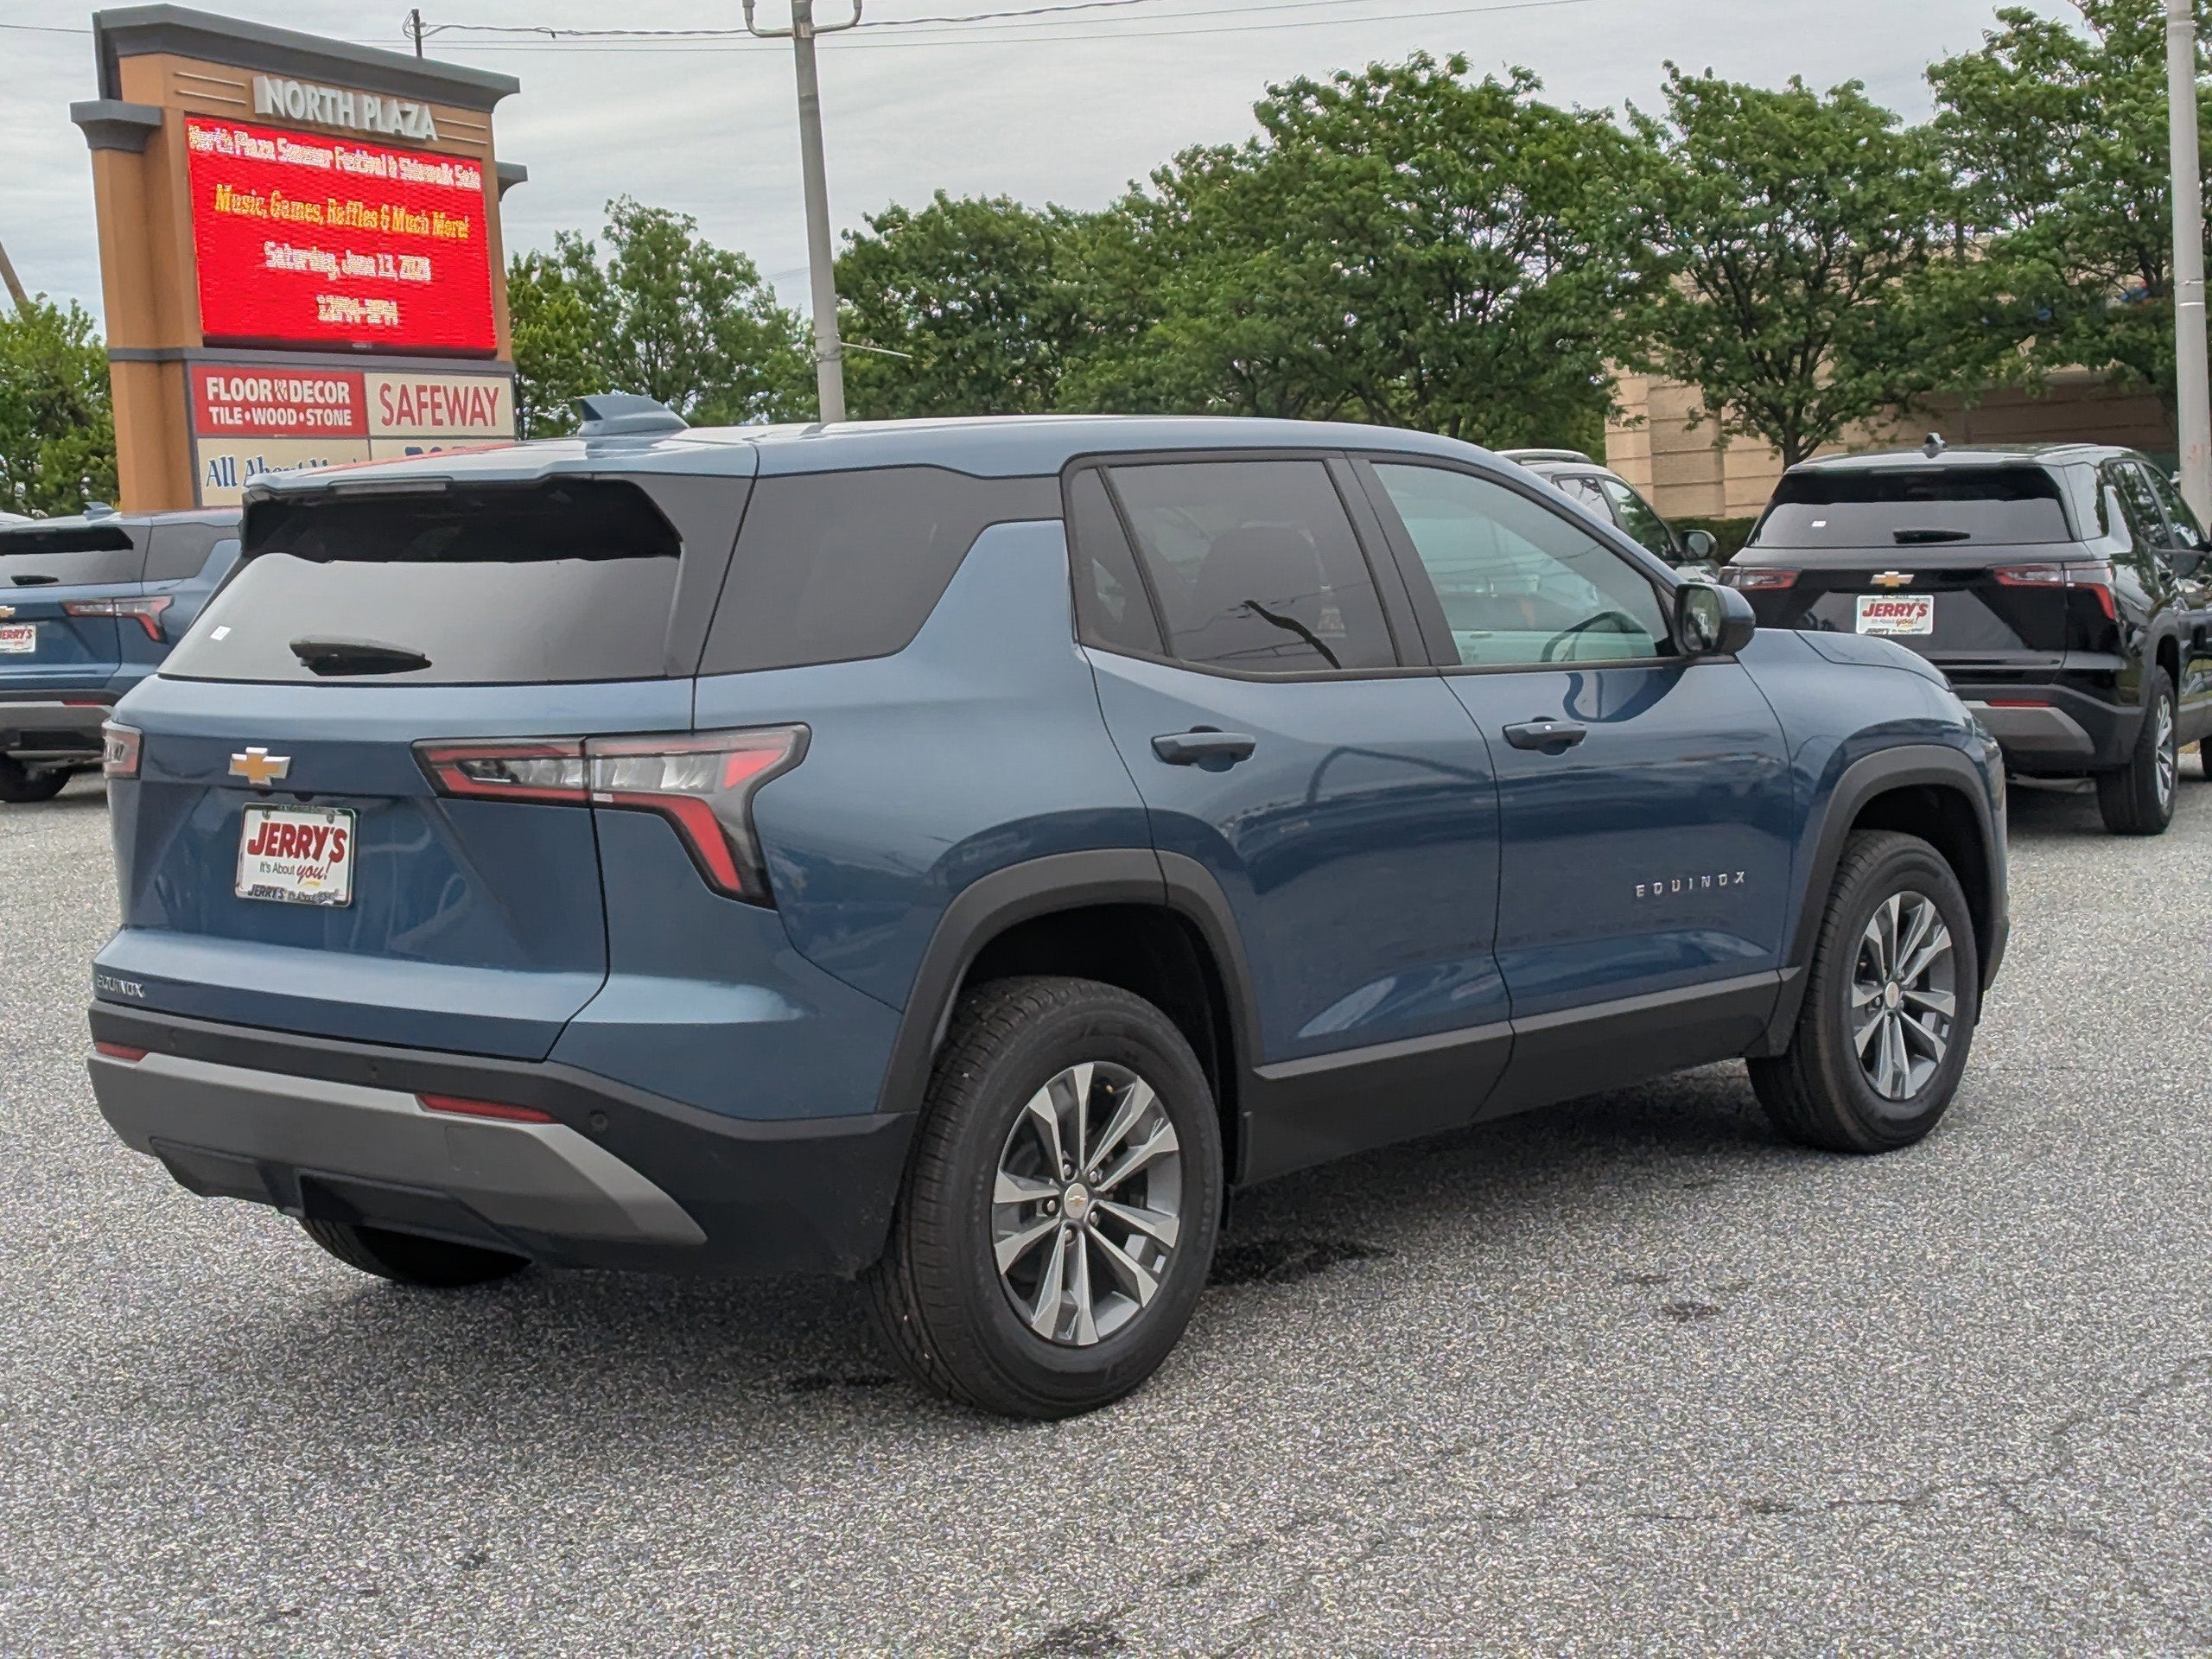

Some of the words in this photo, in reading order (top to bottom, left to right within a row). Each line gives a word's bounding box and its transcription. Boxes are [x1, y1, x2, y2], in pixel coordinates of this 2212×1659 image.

[253, 75, 355, 128] NORTH
[356, 93, 438, 141] PLAZA
[234, 130, 276, 162] Plaza
[214, 183, 269, 219] Music,
[270, 190, 324, 225] Games,
[327, 198, 378, 228] Raffles
[392, 205, 429, 235] Much
[432, 211, 469, 238] More!
[206, 376, 273, 403] FLOOR
[289, 380, 351, 404] DECOR
[208, 406, 244, 425] TILE
[251, 408, 297, 426] WOOD
[306, 409, 353, 427] STONE
[378, 382, 499, 427] SAFEWAY
[206, 455, 238, 488] All
[1862, 603, 1929, 618] JERRY'S
[0, 629, 33, 640] ERRY'S
[247, 822, 347, 863] JERRY'S
[259, 861, 271, 874] It's
[272, 862, 295, 875] About
[296, 861, 331, 884] you!
[1635, 871, 1745, 899] EQUINOX
[97, 974, 146, 999] EQUINOX
